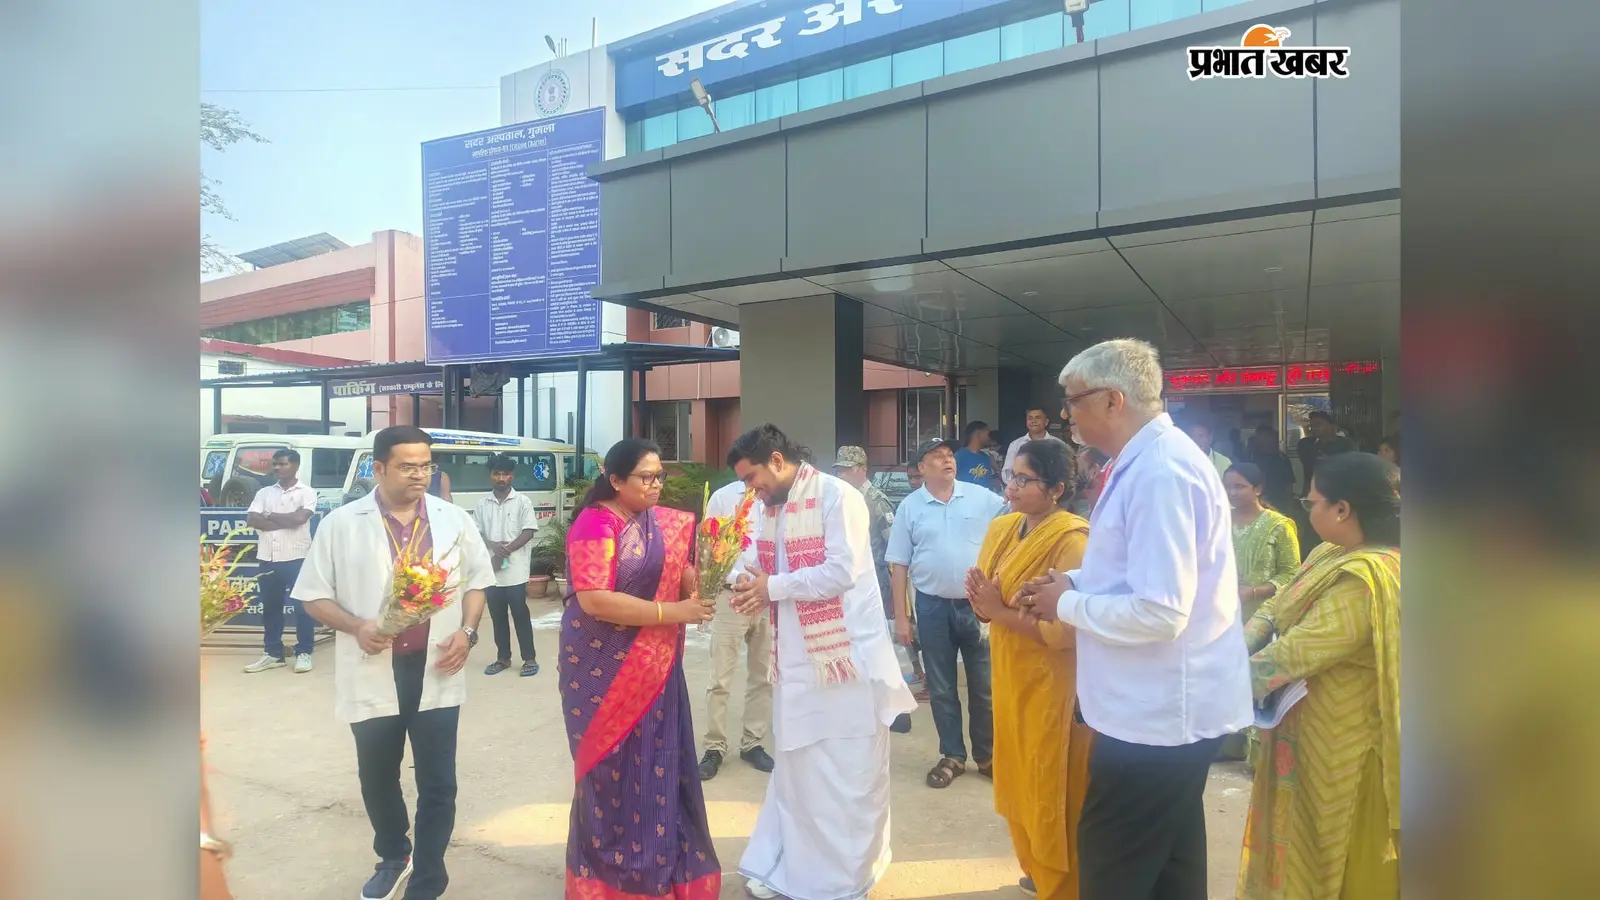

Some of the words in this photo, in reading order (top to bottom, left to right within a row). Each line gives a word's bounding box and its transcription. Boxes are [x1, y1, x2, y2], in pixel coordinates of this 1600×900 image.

[655, 17, 786, 77] सदर
[464, 136, 484, 149] सदर
[486, 129, 526, 145] अस्पताल,
[527, 122, 556, 139] गुमला
[435, 379, 444, 388] लि
